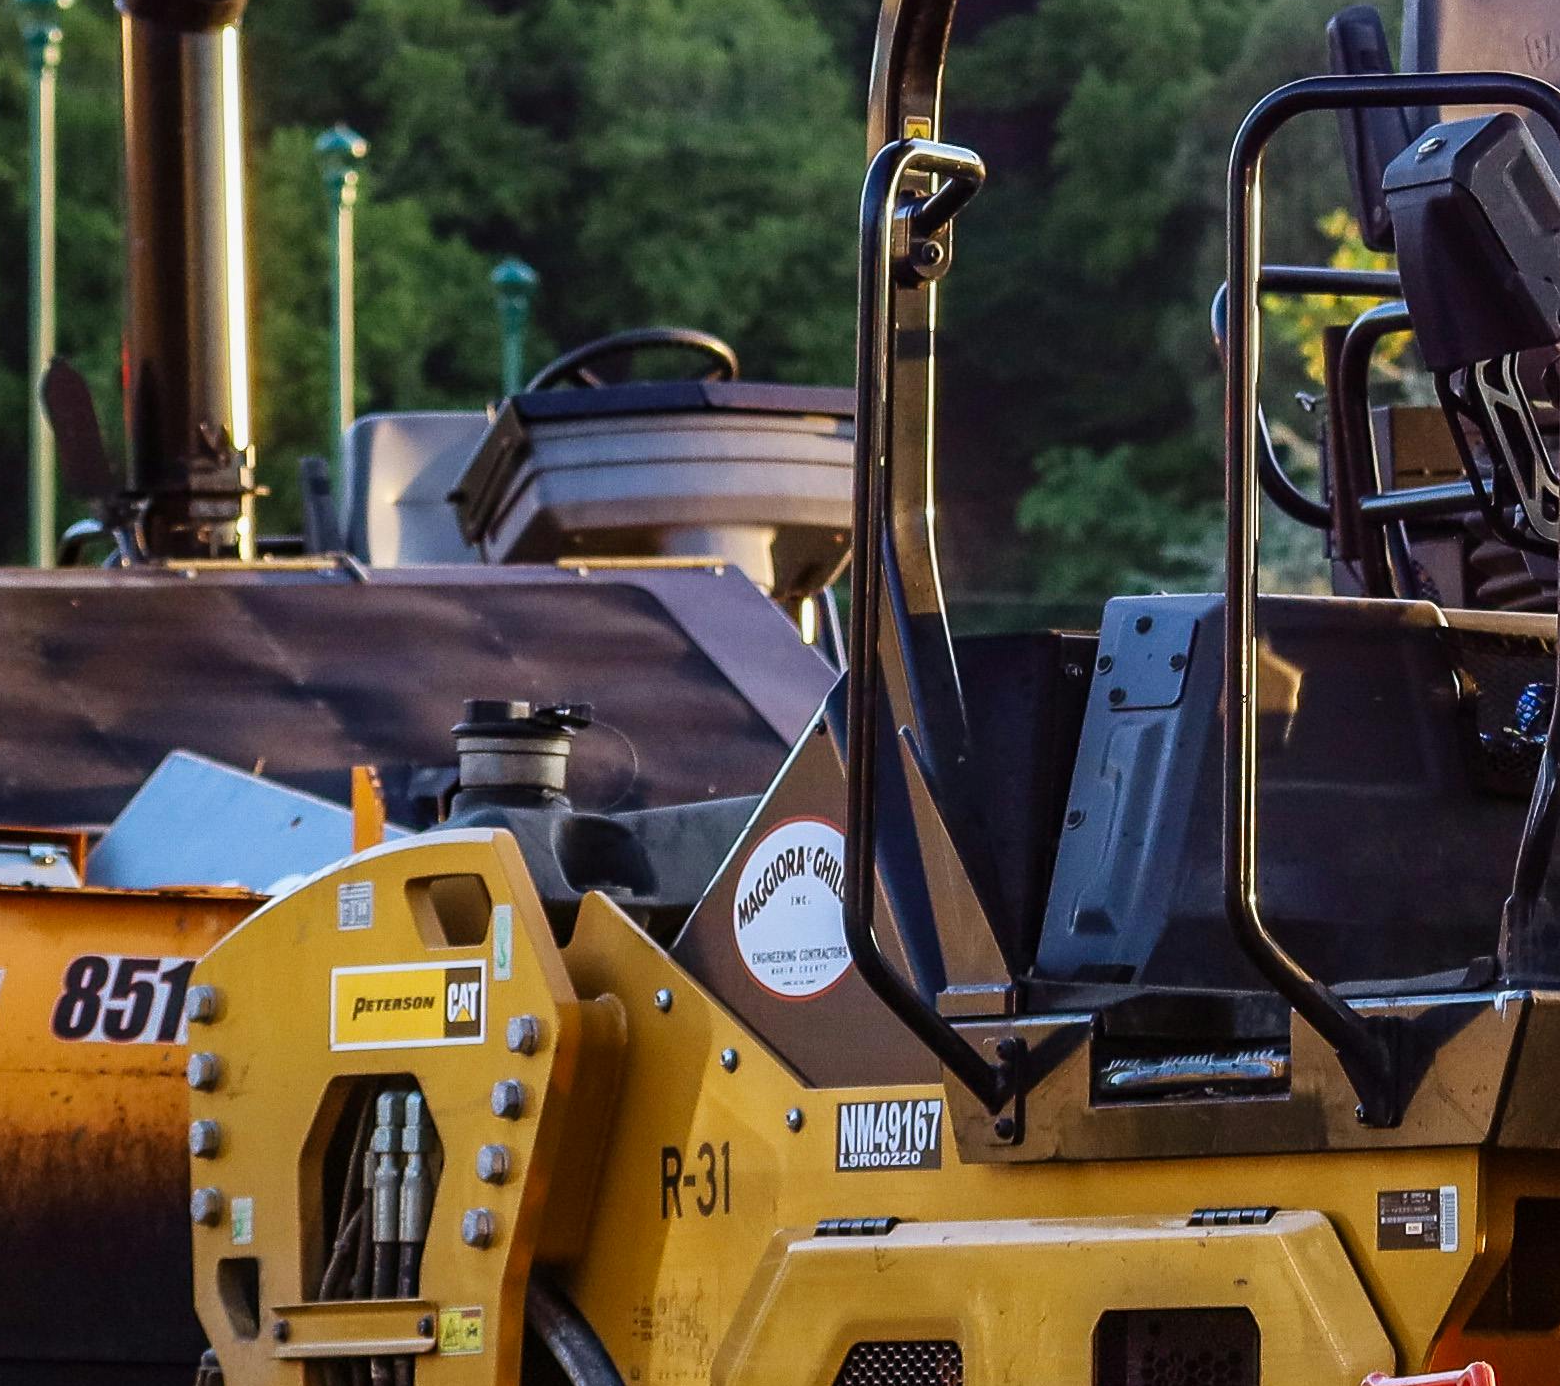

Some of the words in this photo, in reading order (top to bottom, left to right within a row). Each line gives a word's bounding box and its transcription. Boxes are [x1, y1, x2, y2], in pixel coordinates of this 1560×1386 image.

[737, 845, 806, 931] MAGGIORA
[813, 846, 846, 904] GHIL
[352, 995, 436, 1021] PETERSON
[447, 982, 480, 1023] CAT
[840, 1100, 941, 1153] NM49167
[661, 1140, 730, 1220] R-31
[839, 1151, 921, 1168] L9R00220
